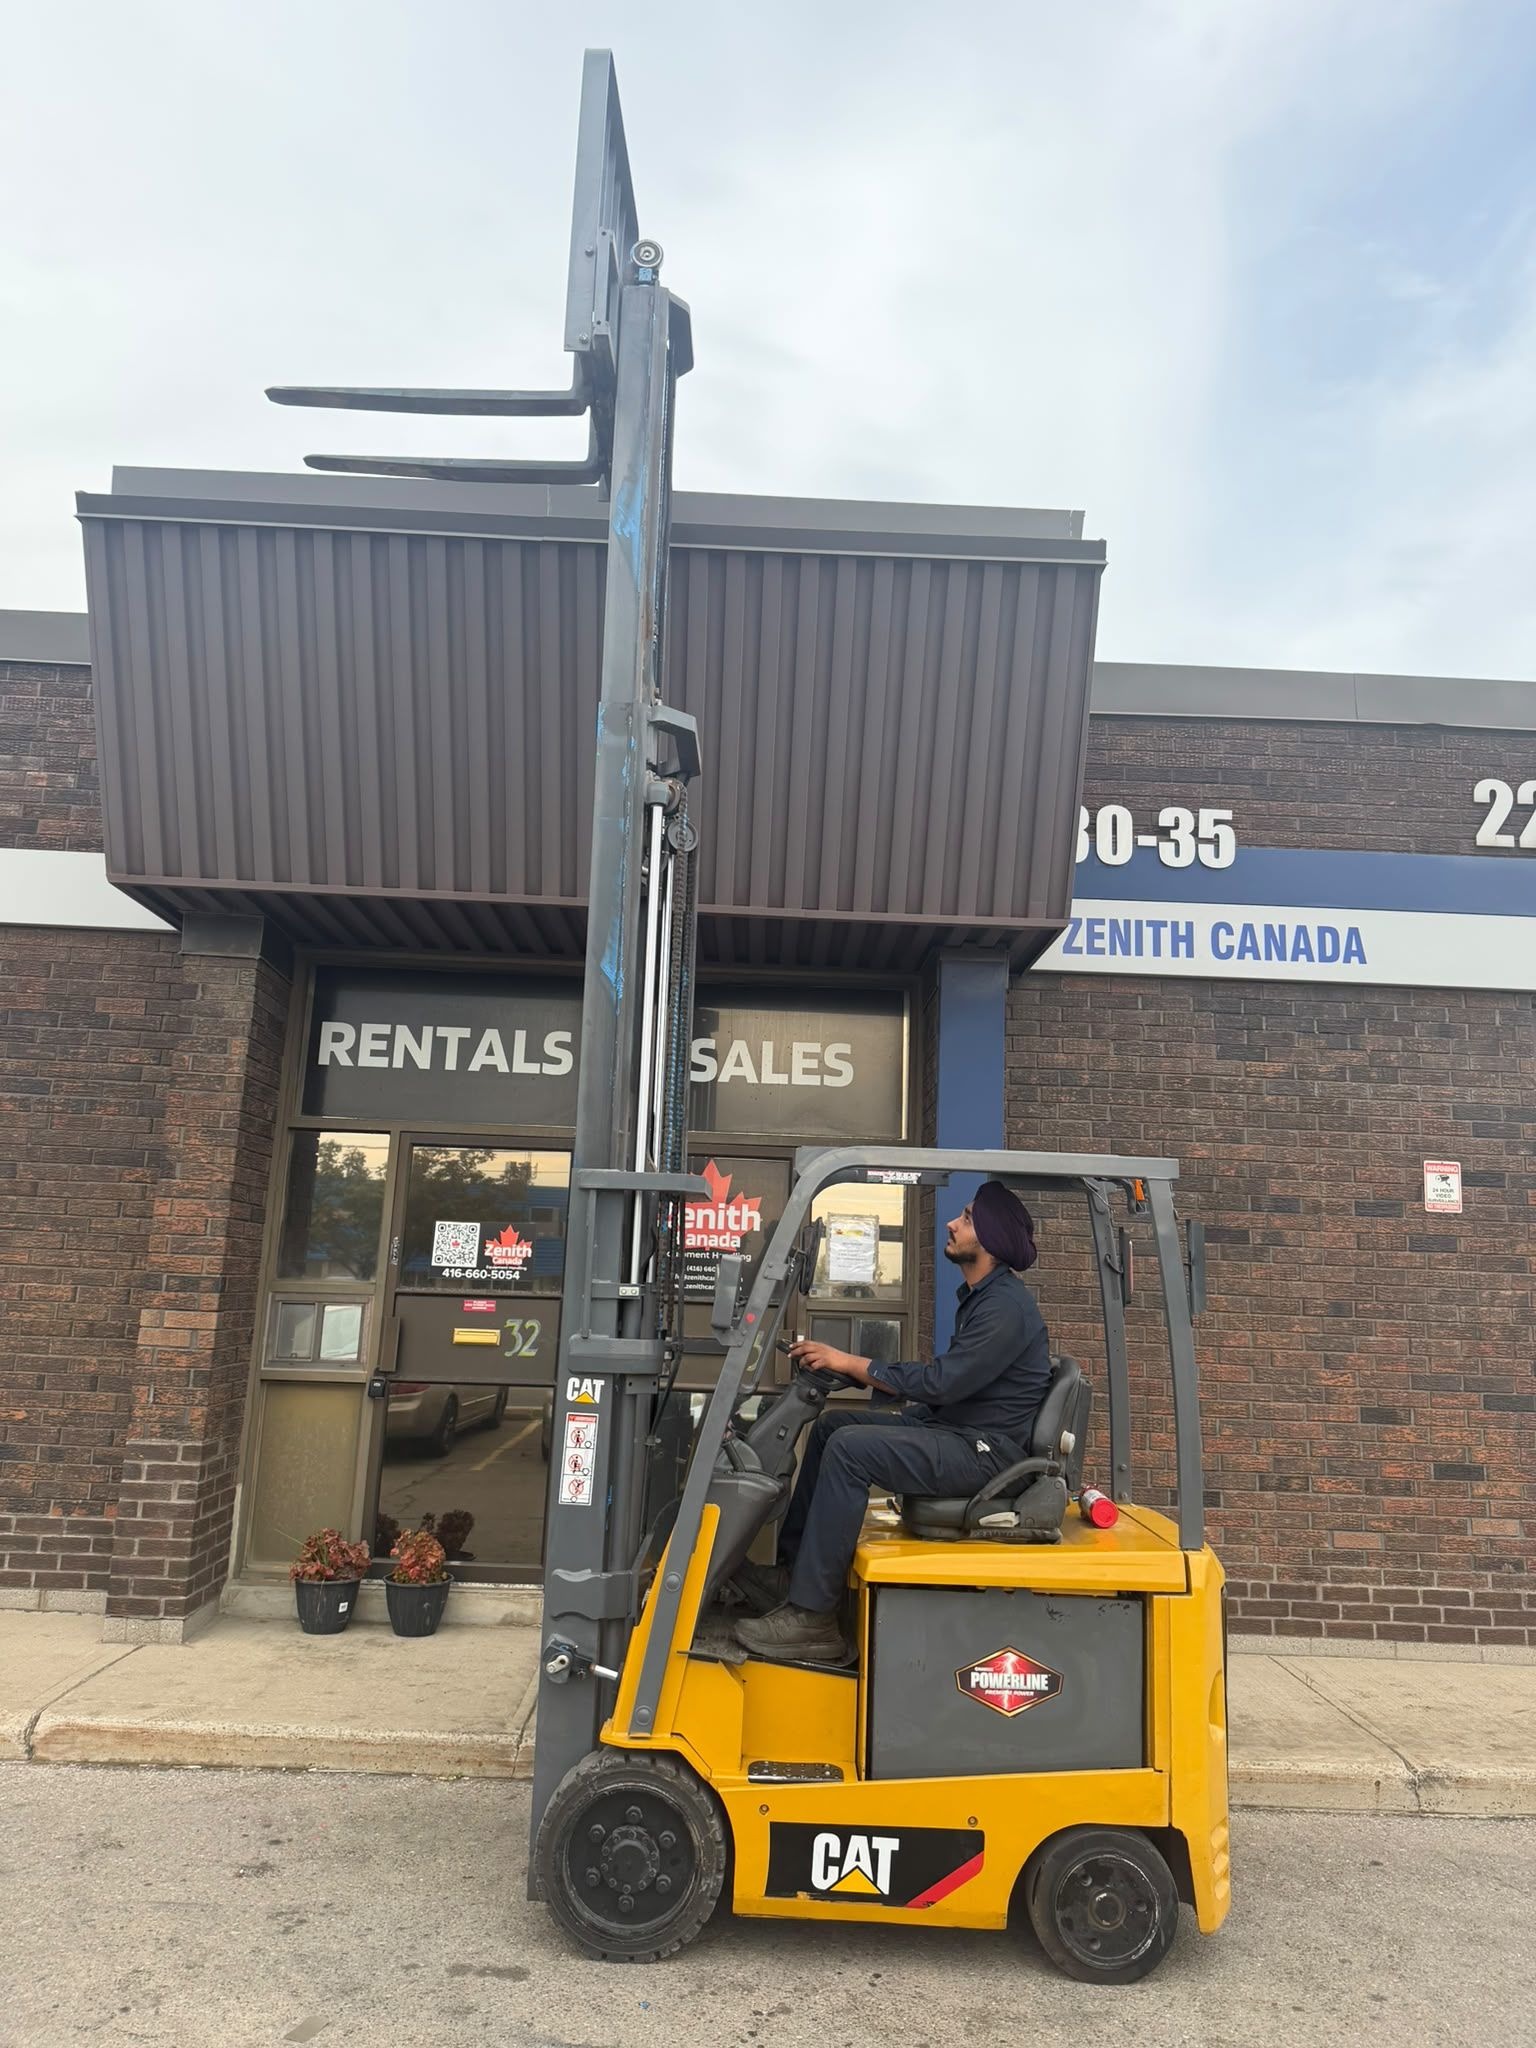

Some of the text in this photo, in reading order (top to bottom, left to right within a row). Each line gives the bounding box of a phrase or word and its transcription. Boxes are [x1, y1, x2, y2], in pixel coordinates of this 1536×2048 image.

[1062, 917, 1367, 965] ZENITH CANADA
[318, 1021, 574, 1076] RENTALS
[689, 1037, 854, 1088] SALES
[667, 1202, 761, 1232] enith
[484, 1243, 533, 1258] Zenith
[676, 1231, 741, 1249] anada
[441, 1267, 520, 1281] 416-660-5054
[492, 1256, 523, 1266] Canada
[503, 1318, 541, 1357] 32
[566, 1377, 605, 1404] CAT
[970, 1672, 1049, 1690] POWERLINE
[811, 1832, 900, 1896] CAT
